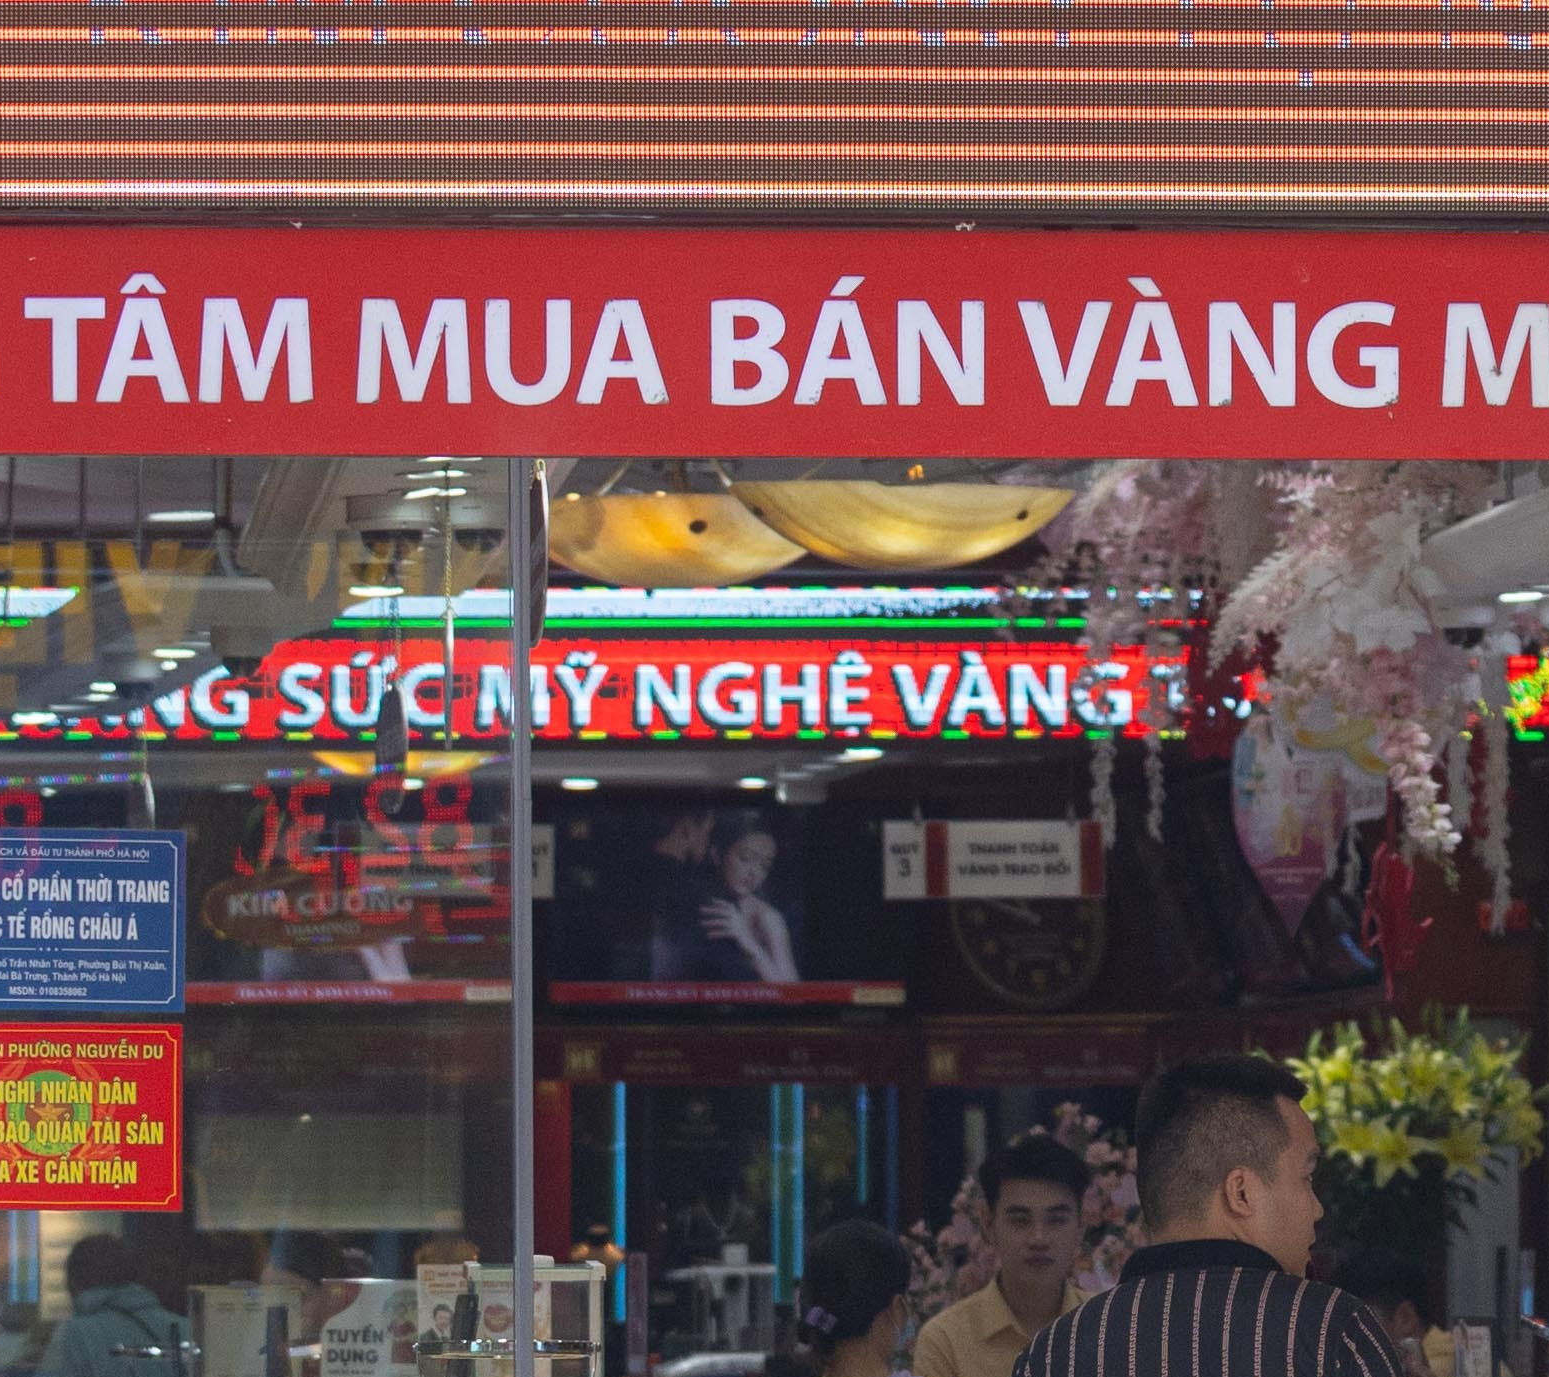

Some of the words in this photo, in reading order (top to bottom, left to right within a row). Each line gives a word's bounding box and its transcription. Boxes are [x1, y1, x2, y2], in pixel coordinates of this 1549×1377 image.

[24, 273, 314, 404] TÂM
[357, 296, 670, 407] MUA
[709, 274, 985, 407] BÁN
[1018, 275, 1399, 408] VÀNG
[279, 650, 449, 729] SỨC
[478, 650, 609, 729] MỸ
[636, 648, 874, 733] NGHỆ
[891, 648, 1133, 727] VÀNG
[1, 869, 24, 901] CỔ
[28, 871, 72, 902] PHẦN
[76, 874, 112, 902] THỜI
[117, 880, 170, 904] TRANG
[8, 908, 27, 939] TẾ
[30, 909, 75, 939] RỒNG
[79, 913, 122, 940] CHÂU
[126, 913, 139, 941] Á
[8, 1041, 72, 1058] PHƯỜNG
[76, 1039, 139, 1059] NGUYỄN
[143, 1045, 163, 1059] DU
[41, 1077, 93, 1104] NHÂN
[98, 1077, 137, 1104] DÂN
[35, 1114, 87, 1144] QUẢN
[92, 1117, 120, 1144] TÀI
[126, 1114, 164, 1145] SẢN
[16, 1161, 39, 1183] XE
[45, 1152, 84, 1184] CẨN
[89, 1156, 137, 1189] THẬN
[325, 1348, 379, 1368] DỤNG
